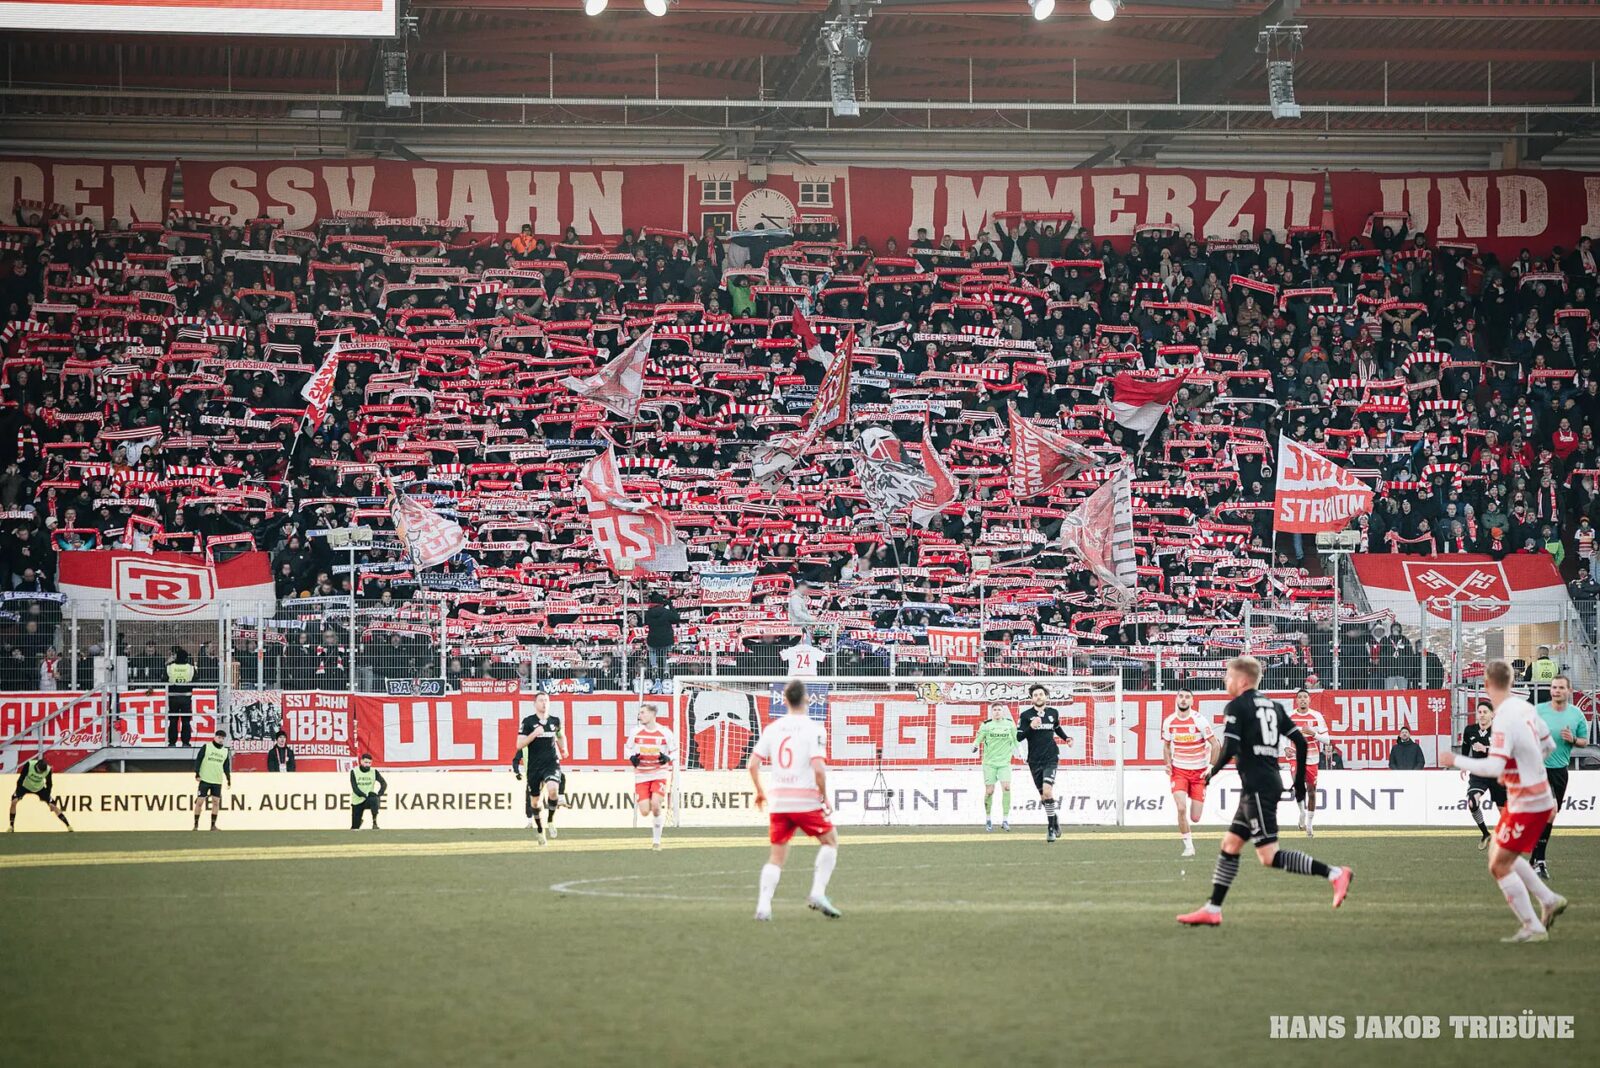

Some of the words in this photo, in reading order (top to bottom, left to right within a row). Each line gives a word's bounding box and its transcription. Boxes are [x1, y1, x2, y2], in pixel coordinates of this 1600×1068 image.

[209, 166, 376, 231] SSV
[908, 174, 1316, 244] IMMERZU
[1380, 175, 1549, 240] UND
[796, 654, 810, 669] 24
[286, 695, 312, 708] SSV
[315, 694, 348, 709] JAHN
[1331, 695, 1418, 732] JAHN
[286, 710, 349, 742] 1889
[1256, 707, 1279, 747] 13
[778, 736, 793, 769] 6
[53, 794, 92, 812] WIR
[101, 794, 251, 812] ENTWICELN.
[260, 793, 317, 811] AUCH
[325, 793, 387, 811] DEE
[396, 793, 512, 811] KARRIERE!
[835, 789, 967, 811] POINT
